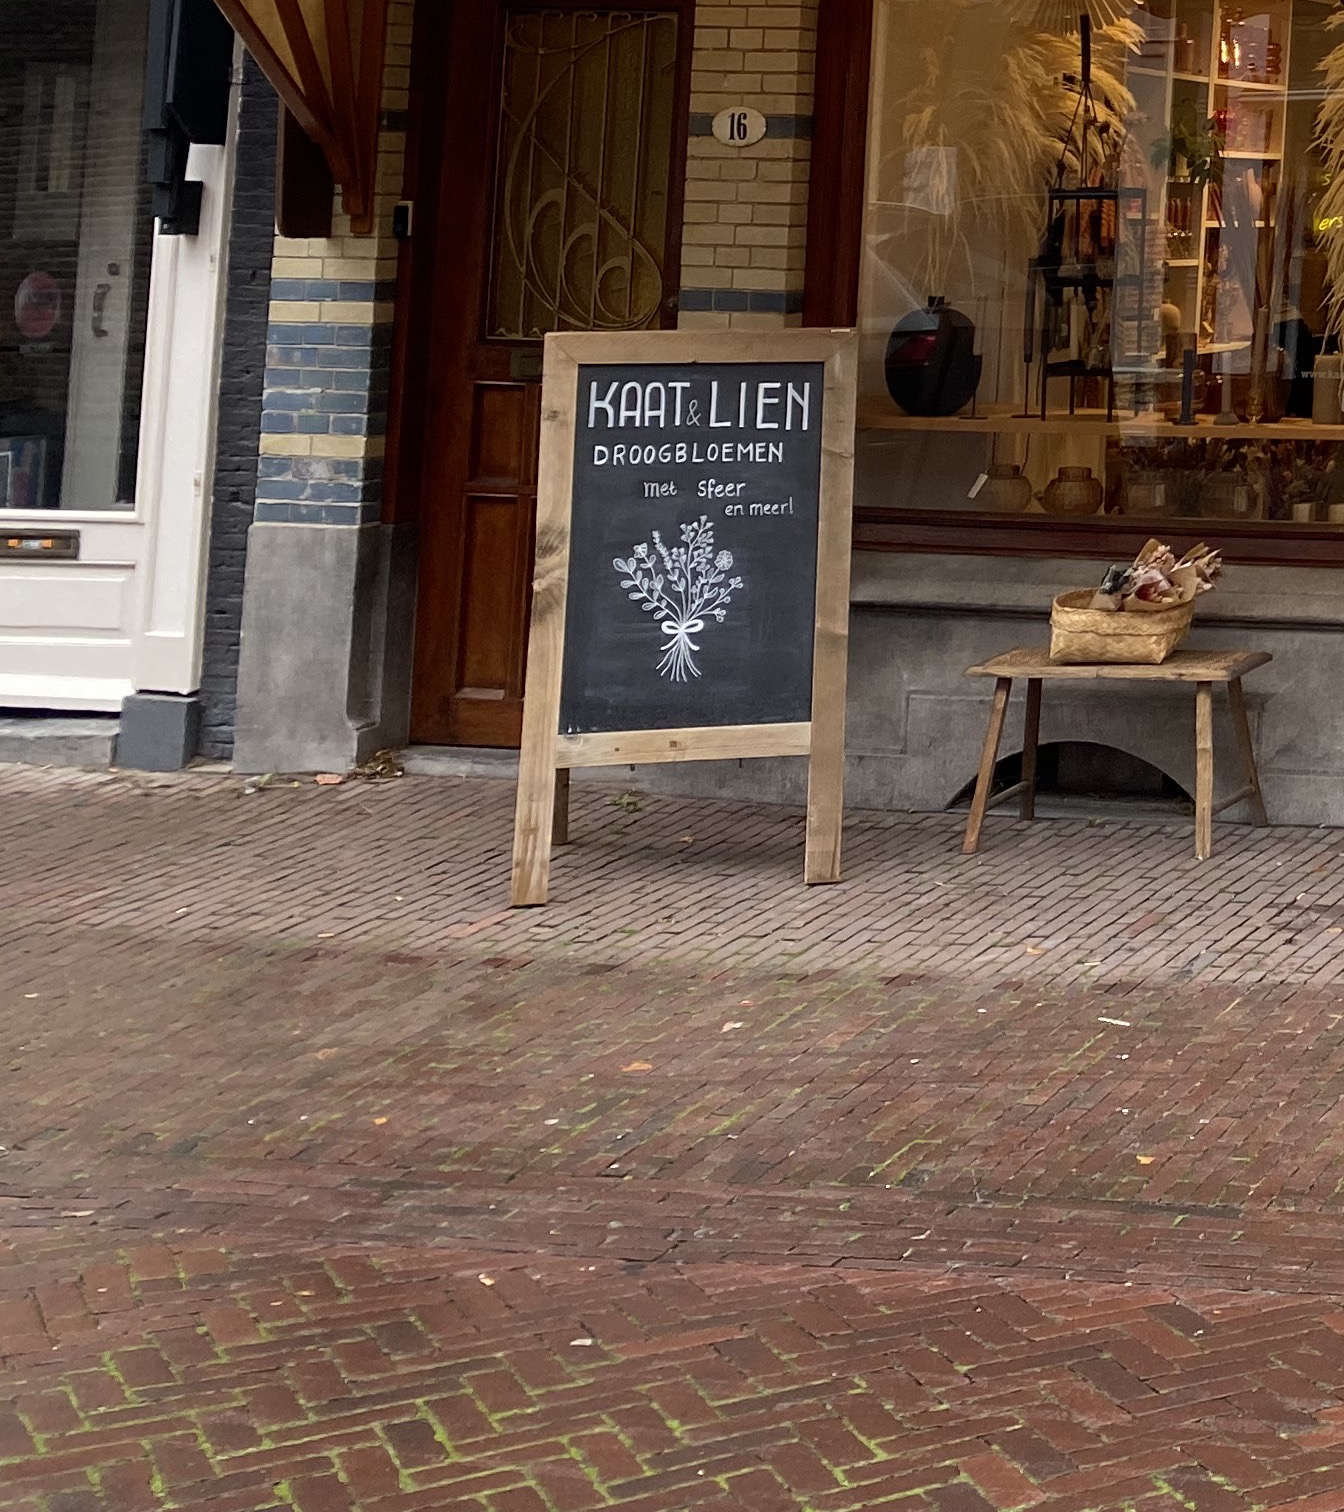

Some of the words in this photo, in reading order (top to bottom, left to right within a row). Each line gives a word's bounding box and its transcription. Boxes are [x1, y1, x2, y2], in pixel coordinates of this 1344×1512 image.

[728, 112, 748, 141] 16
[588, 381, 691, 428] KAAT
[686, 399, 701, 427] &
[709, 380, 810, 431] LIEN
[593, 441, 784, 466] DROOGBLOEMEN
[643, 480, 678, 498] met
[724, 503, 744, 516] en
[749, 496, 794, 516] meer!
